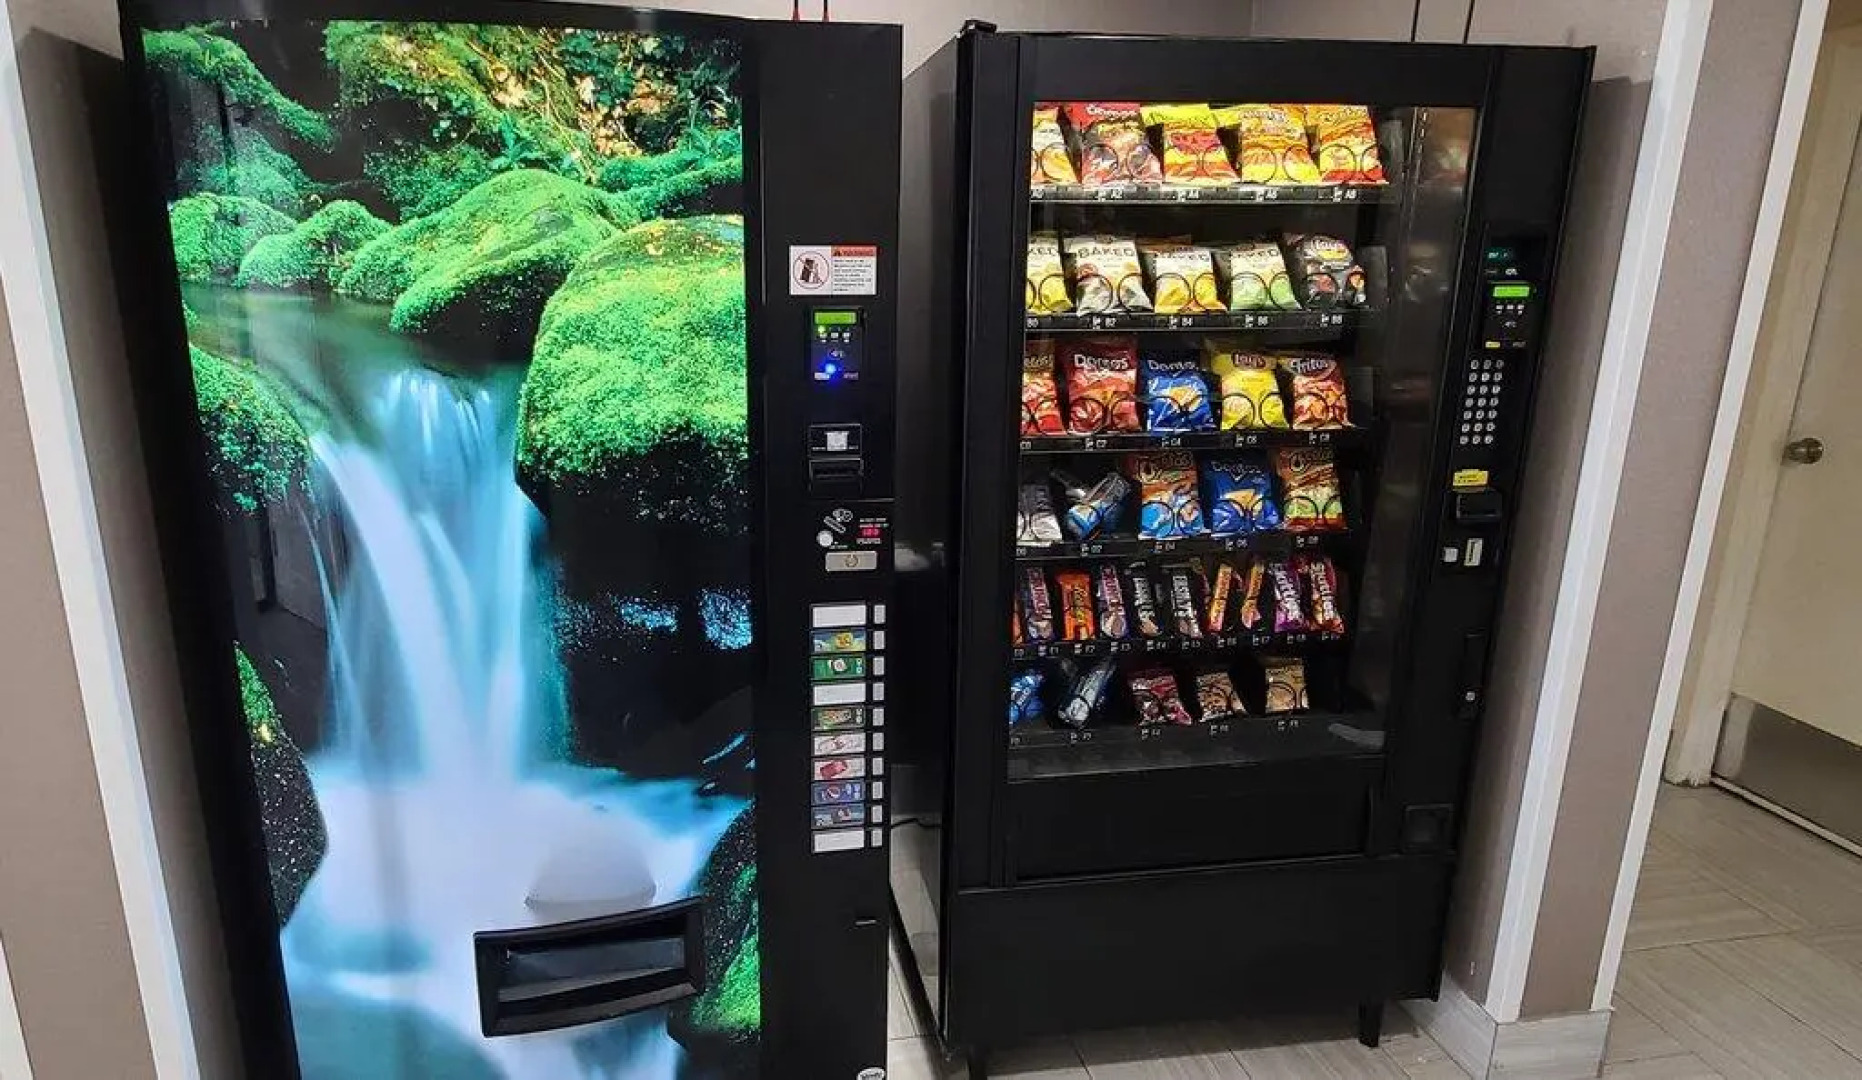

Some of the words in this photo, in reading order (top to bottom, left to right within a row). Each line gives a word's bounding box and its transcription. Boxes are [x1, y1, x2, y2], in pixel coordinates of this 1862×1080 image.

[1078, 246, 1135, 259] BAKED
[1074, 353, 1130, 370] Doritos
[1147, 358, 1200, 371] Doritos
[1290, 357, 1330, 374] Fritos
